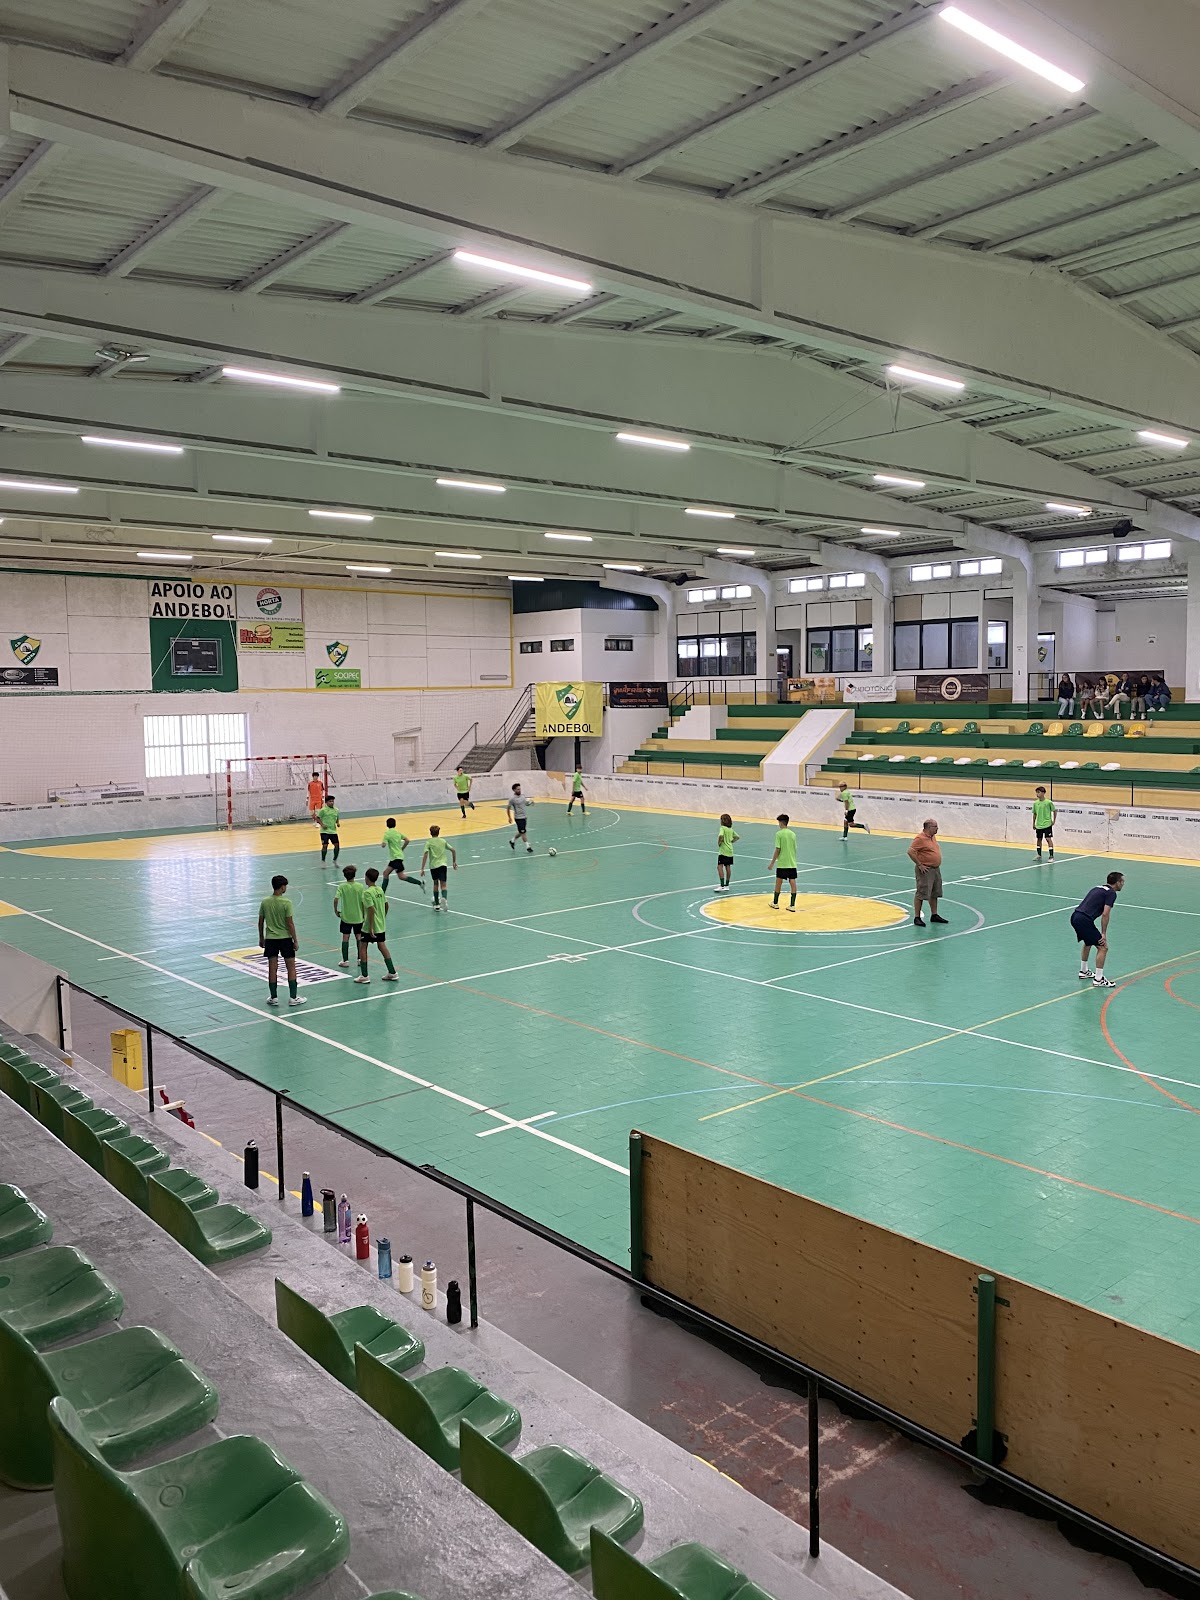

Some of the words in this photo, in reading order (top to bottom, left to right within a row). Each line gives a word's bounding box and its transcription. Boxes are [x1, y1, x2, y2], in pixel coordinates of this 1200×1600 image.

[151, 583, 205, 599] APOIO
[210, 585, 233, 600] AO
[259, 597, 280, 606] HORTA
[152, 602, 235, 619] ANDEBOL
[542, 723, 594, 733] ANDEBOL
